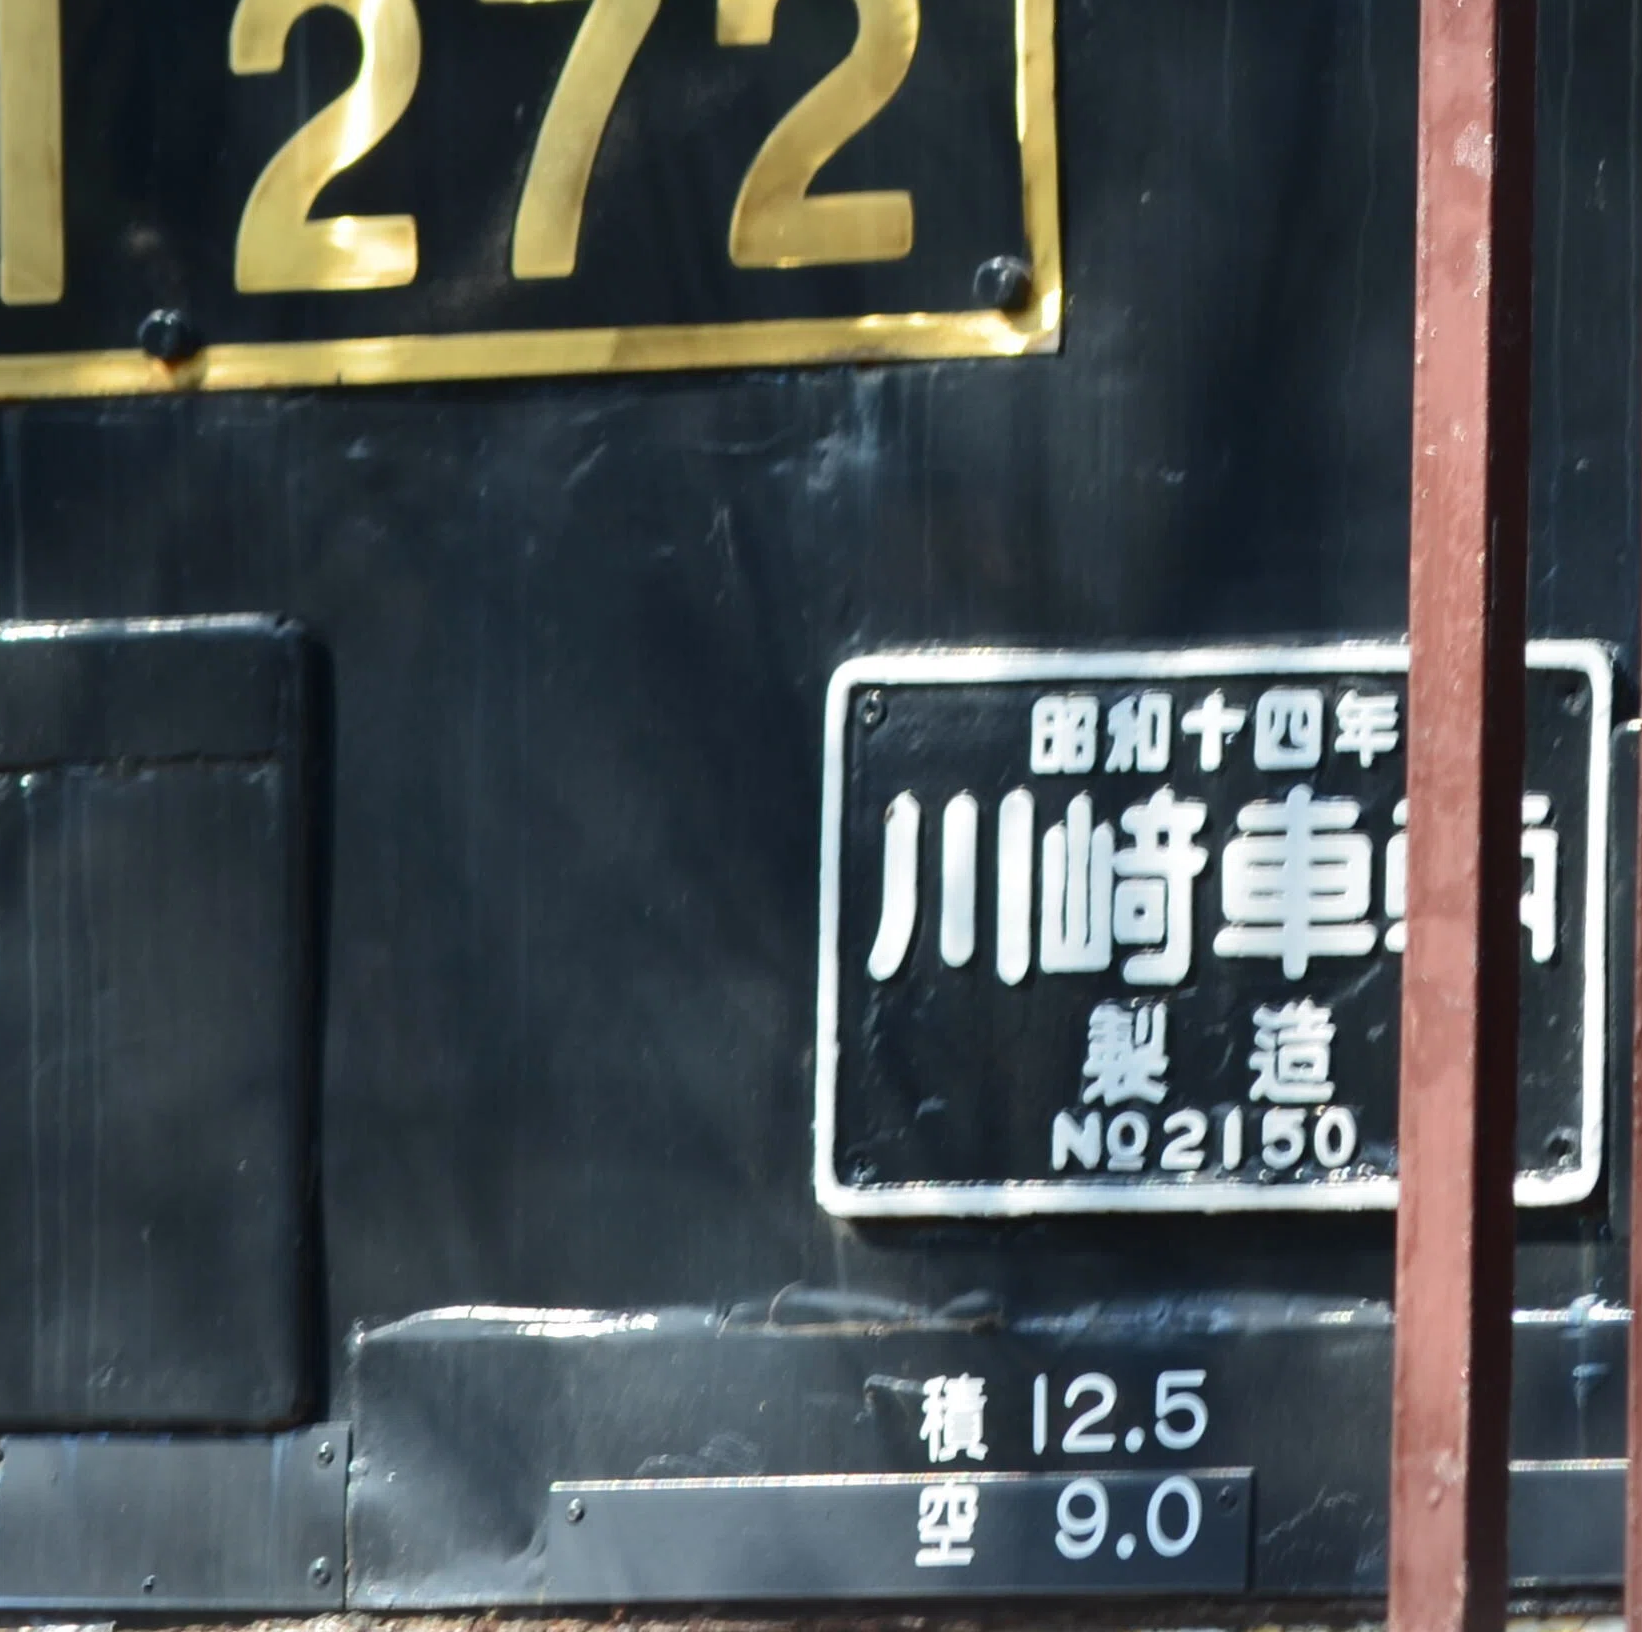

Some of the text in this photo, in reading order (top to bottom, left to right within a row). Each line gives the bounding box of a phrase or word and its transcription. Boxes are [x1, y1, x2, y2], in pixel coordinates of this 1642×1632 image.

[1030, 686, 1400, 775] 昭和十四年
[1033, 1370, 1207, 1455] 12.5
[914, 1475, 1203, 1567] 空 9.0
